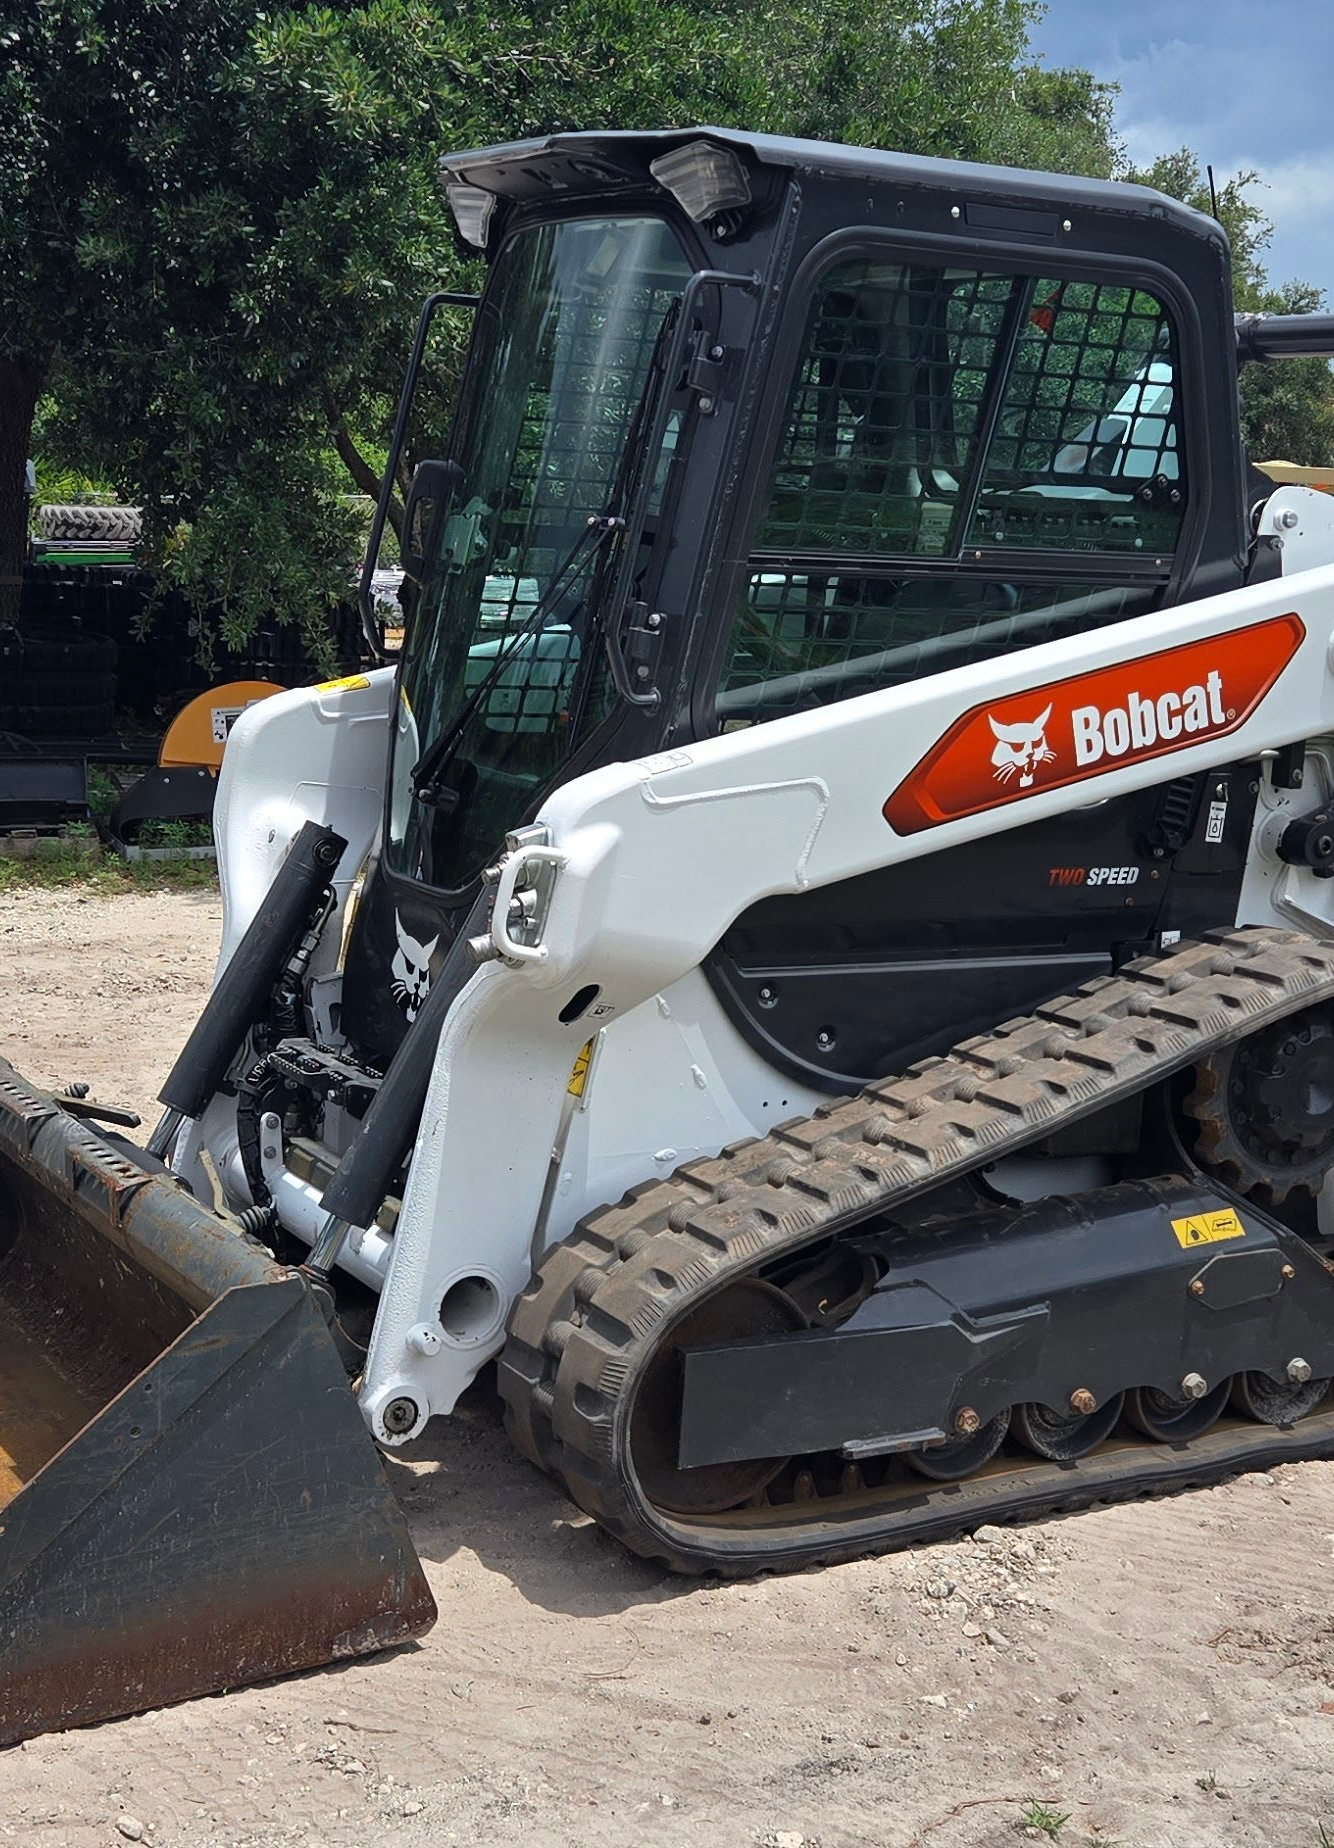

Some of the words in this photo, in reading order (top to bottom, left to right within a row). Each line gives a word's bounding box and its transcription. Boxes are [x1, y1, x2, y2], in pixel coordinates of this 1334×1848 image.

[1071, 670, 1226, 767] Bobcat
[1049, 868, 1085, 886] TWO
[1087, 867, 1140, 886] SPEED
